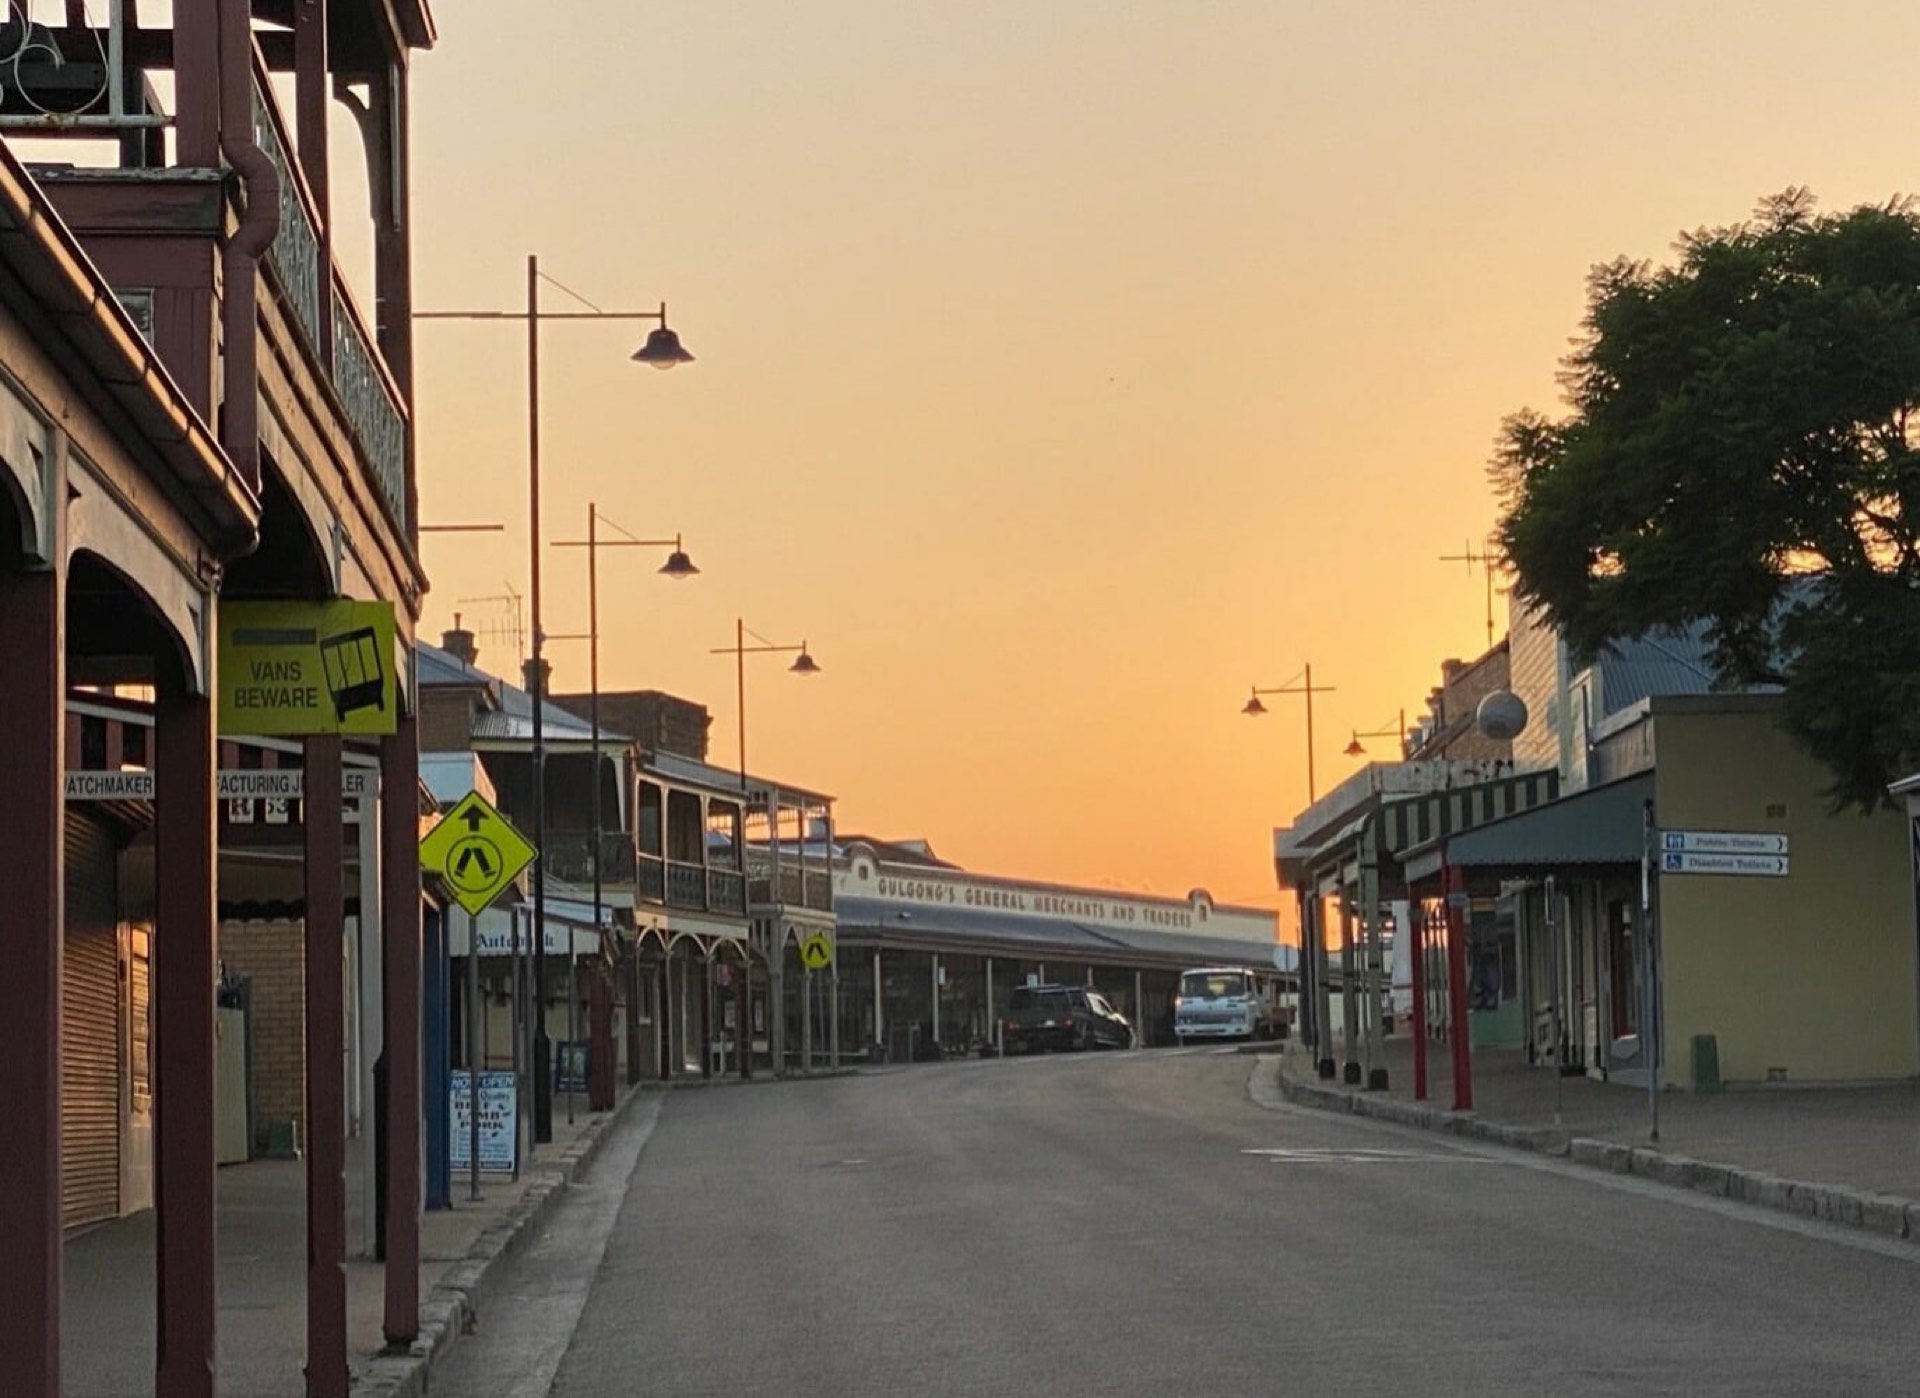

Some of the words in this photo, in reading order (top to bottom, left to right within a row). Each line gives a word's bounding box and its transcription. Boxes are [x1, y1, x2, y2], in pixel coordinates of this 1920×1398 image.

[250, 660, 302, 681] VANS
[234, 687, 319, 708] BEWARE
[217, 775, 289, 794] ACTURING
[878, 877, 954, 903] GULGONG'S
[965, 887, 1026, 910] GENERAL
[1033, 896, 1105, 918] MERCHANTS
[1113, 905, 1136, 922] AND
[1143, 908, 1191, 928] TRADERS
